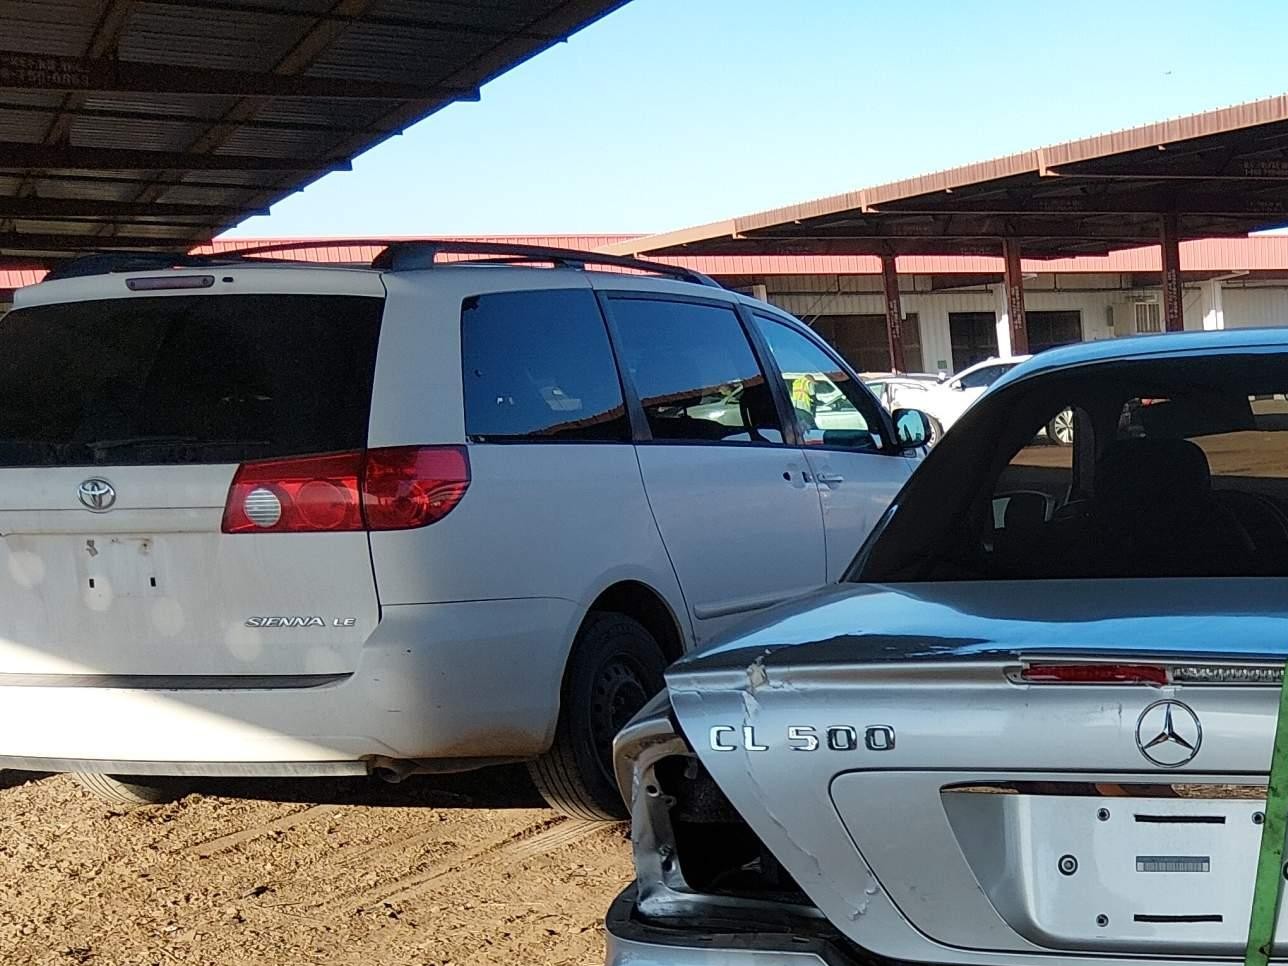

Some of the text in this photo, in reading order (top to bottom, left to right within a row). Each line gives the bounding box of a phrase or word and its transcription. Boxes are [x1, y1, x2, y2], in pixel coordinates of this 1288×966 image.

[245, 616, 357, 628] SIENNA LE
[709, 725, 896, 752] CL 500
